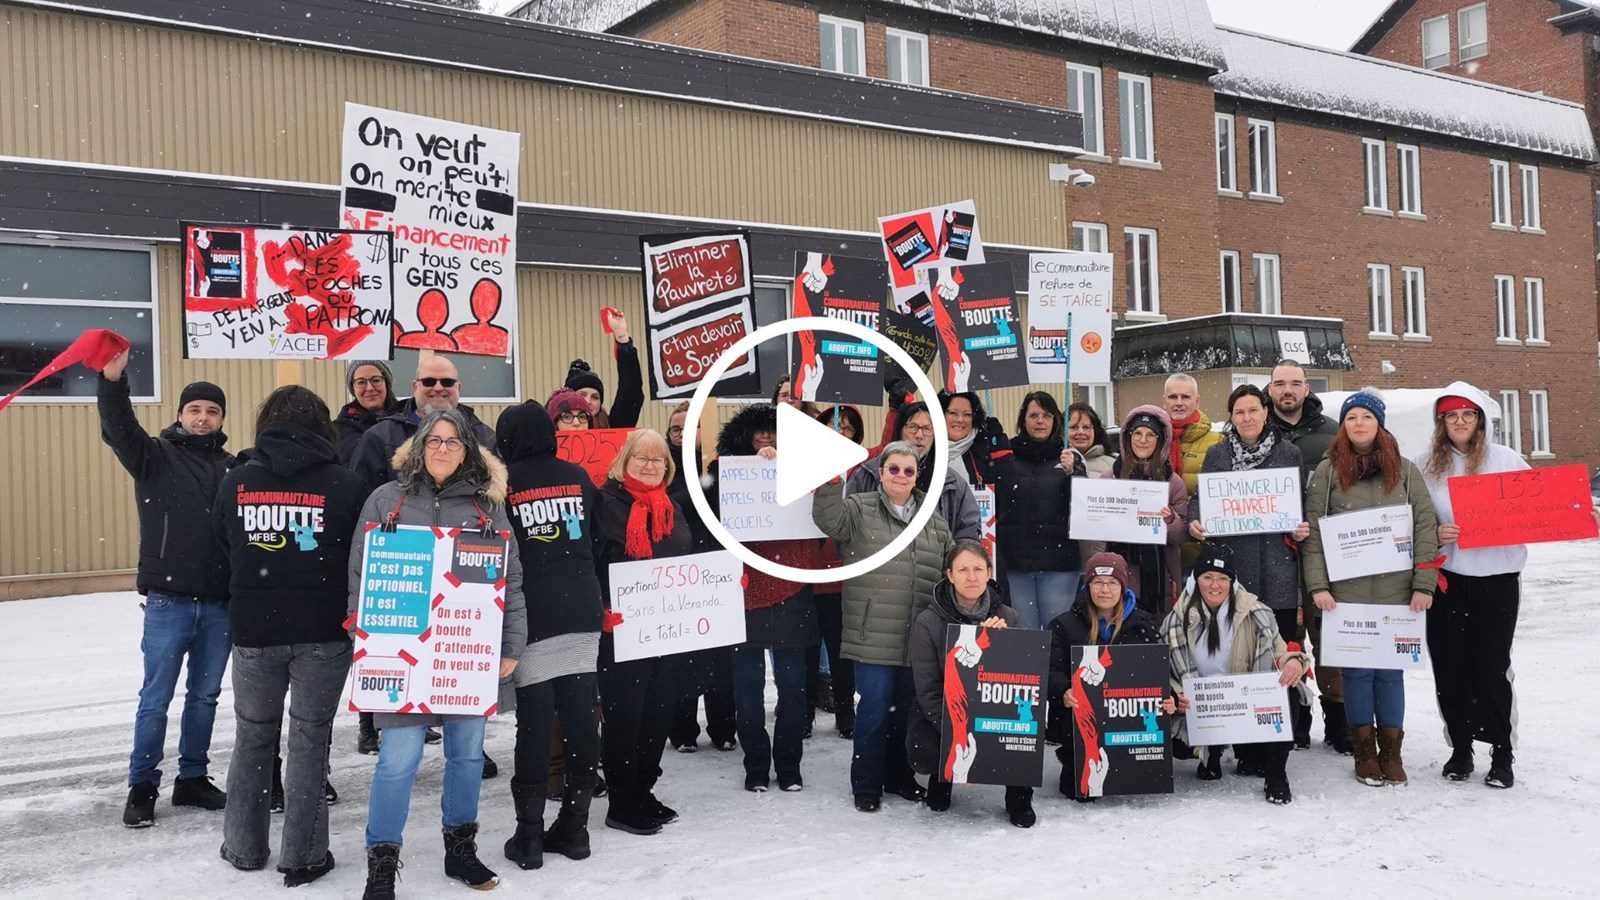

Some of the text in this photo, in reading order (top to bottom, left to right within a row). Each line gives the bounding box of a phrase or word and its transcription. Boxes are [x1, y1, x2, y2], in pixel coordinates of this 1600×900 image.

[358, 117, 403, 150] On
[400, 156, 432, 176] on
[350, 162, 471, 207] On mérite
[429, 203, 495, 231] mieux
[364, 211, 511, 256] Financement
[419, 247, 461, 270] tous
[470, 257, 503, 275] ces
[655, 244, 730, 274] Eliminer
[1031, 256, 1046, 274] Le
[300, 258, 338, 276] LES
[687, 264, 704, 281] la
[305, 275, 383, 294] POCHES
[406, 267, 459, 289] GENS
[1040, 278, 1093, 290] refuse de
[656, 266, 737, 307] Pauvreté
[327, 294, 353, 306] DU
[823, 297, 880, 311] COMMUNAUTAIRE
[959, 297, 1010, 310] COMMUNAUTAIRE
[1040, 294, 1056, 307] SE
[212, 308, 235, 327] DE
[965, 306, 1013, 327] BOUTTE
[700, 319, 742, 344] devoir
[282, 338, 326, 352] ACEF
[828, 343, 872, 355] ABOUTTE.INFO
[971, 336, 1011, 348] ABOUTTE.INFO
[1284, 342, 1305, 353] CLSC
[666, 360, 684, 378] de
[556, 432, 618, 467] 3025
[721, 468, 757, 481] APPELS
[237, 484, 245, 492] LE
[1207, 476, 1294, 498] ELIMINER LA
[1497, 472, 1544, 500] 133
[237, 492, 326, 507] COMMUNAUTAIRE
[509, 484, 583, 505] COMMUNAUTAIRE
[721, 492, 754, 505] APPELS
[244, 505, 324, 533] BOUTTE
[518, 496, 585, 528] BOUTTE
[722, 516, 773, 529] ACCUEILS
[1138, 517, 1161, 527] BOUTTE
[248, 532, 277, 542] MFBE
[527, 524, 553, 537] MFBE
[1358, 529, 1368, 537] 500
[372, 534, 385, 546] Le
[370, 551, 431, 561] communautaire
[459, 551, 502, 568] BOUTTE
[369, 562, 424, 577] n'est pas
[367, 579, 428, 595] OPTIONNEL,
[617, 564, 733, 607] portions 7550 Repas
[377, 598, 397, 609] est
[437, 607, 481, 620] On est à
[626, 604, 655, 618] Sans
[364, 614, 419, 628] ESSENTIEL
[1356, 620, 1363, 628] de
[436, 624, 472, 637] boutte
[639, 629, 651, 644] Le
[656, 622, 682, 641] Total
[697, 618, 710, 635] 0
[434, 641, 494, 656] d'attendre,
[1396, 643, 1421, 653] BOUTTE
[433, 658, 490, 672] On veut se
[358, 668, 405, 677] COMMUNAUTAIRE
[977, 672, 1040, 685] COMMUNAUTAIRE
[361, 677, 404, 692] BOUTTE
[431, 676, 457, 688] faire
[1194, 681, 1234, 691] 241 animations
[981, 683, 1040, 706] BOUTTE
[1103, 687, 1162, 698] COMMUNAUTAIRE
[1206, 693, 1224, 702] appels
[429, 694, 480, 706] entendre
[1209, 702, 1248, 712] participations
[1108, 697, 1164, 718] BOUTTE
[1257, 713, 1283, 725] BOUTTE
[981, 721, 1030, 732] ABOUTTE.INFO
[1111, 733, 1157, 743] ABOUTTE.INFO
